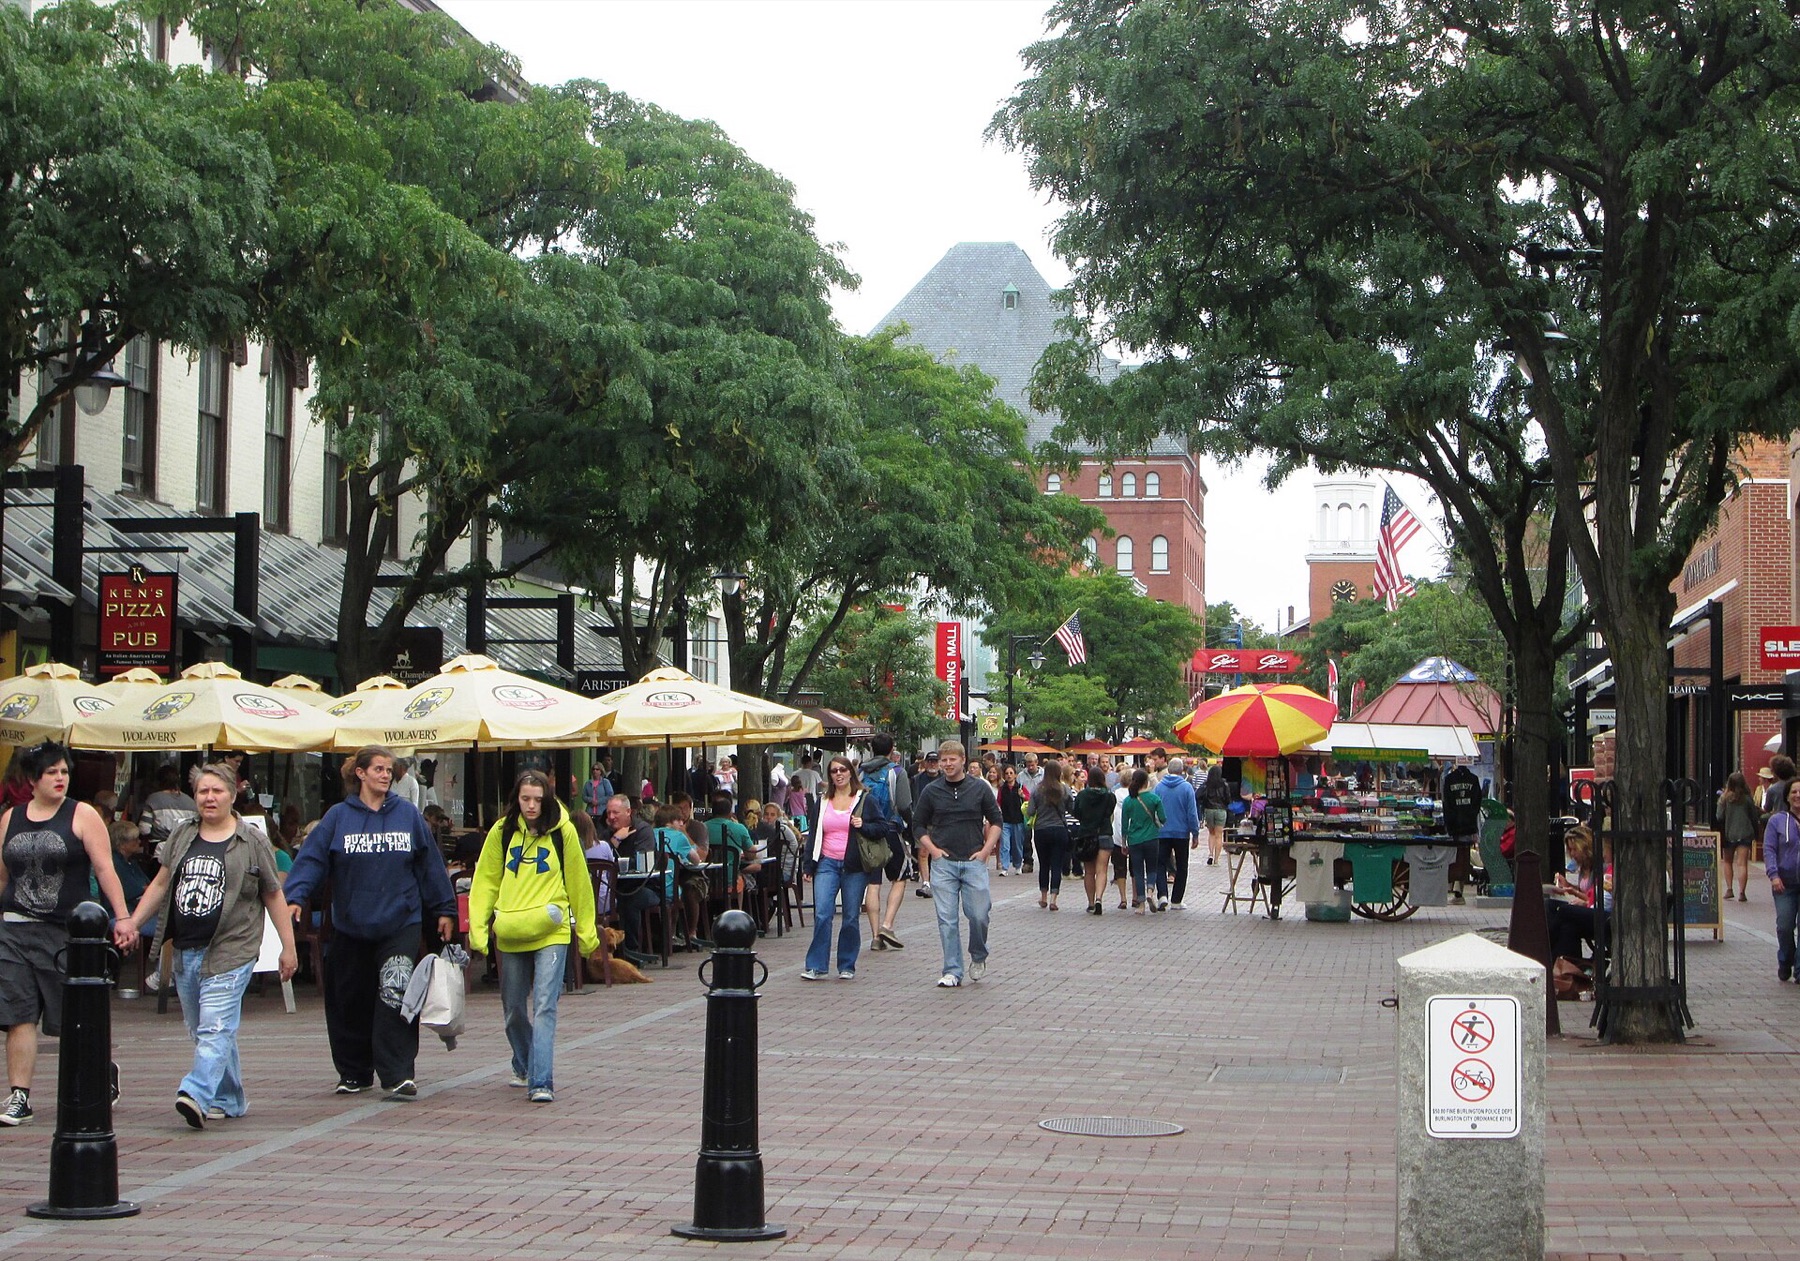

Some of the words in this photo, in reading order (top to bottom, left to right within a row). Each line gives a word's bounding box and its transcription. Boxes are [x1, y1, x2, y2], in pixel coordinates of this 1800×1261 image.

[110, 588, 163, 598] KEN'S
[106, 603, 165, 617] PIZZA
[113, 632, 157, 646] PUB
[946, 625, 957, 656] MALL
[1669, 686, 1696, 694] LEAHY
[122, 731, 177, 744] WOLAVER'S
[384, 729, 437, 743] WOLAVER'S
[344, 832, 411, 846] BURLINGTON
[344, 842, 373, 854] TRACK
[388, 841, 412, 853] FIELD
